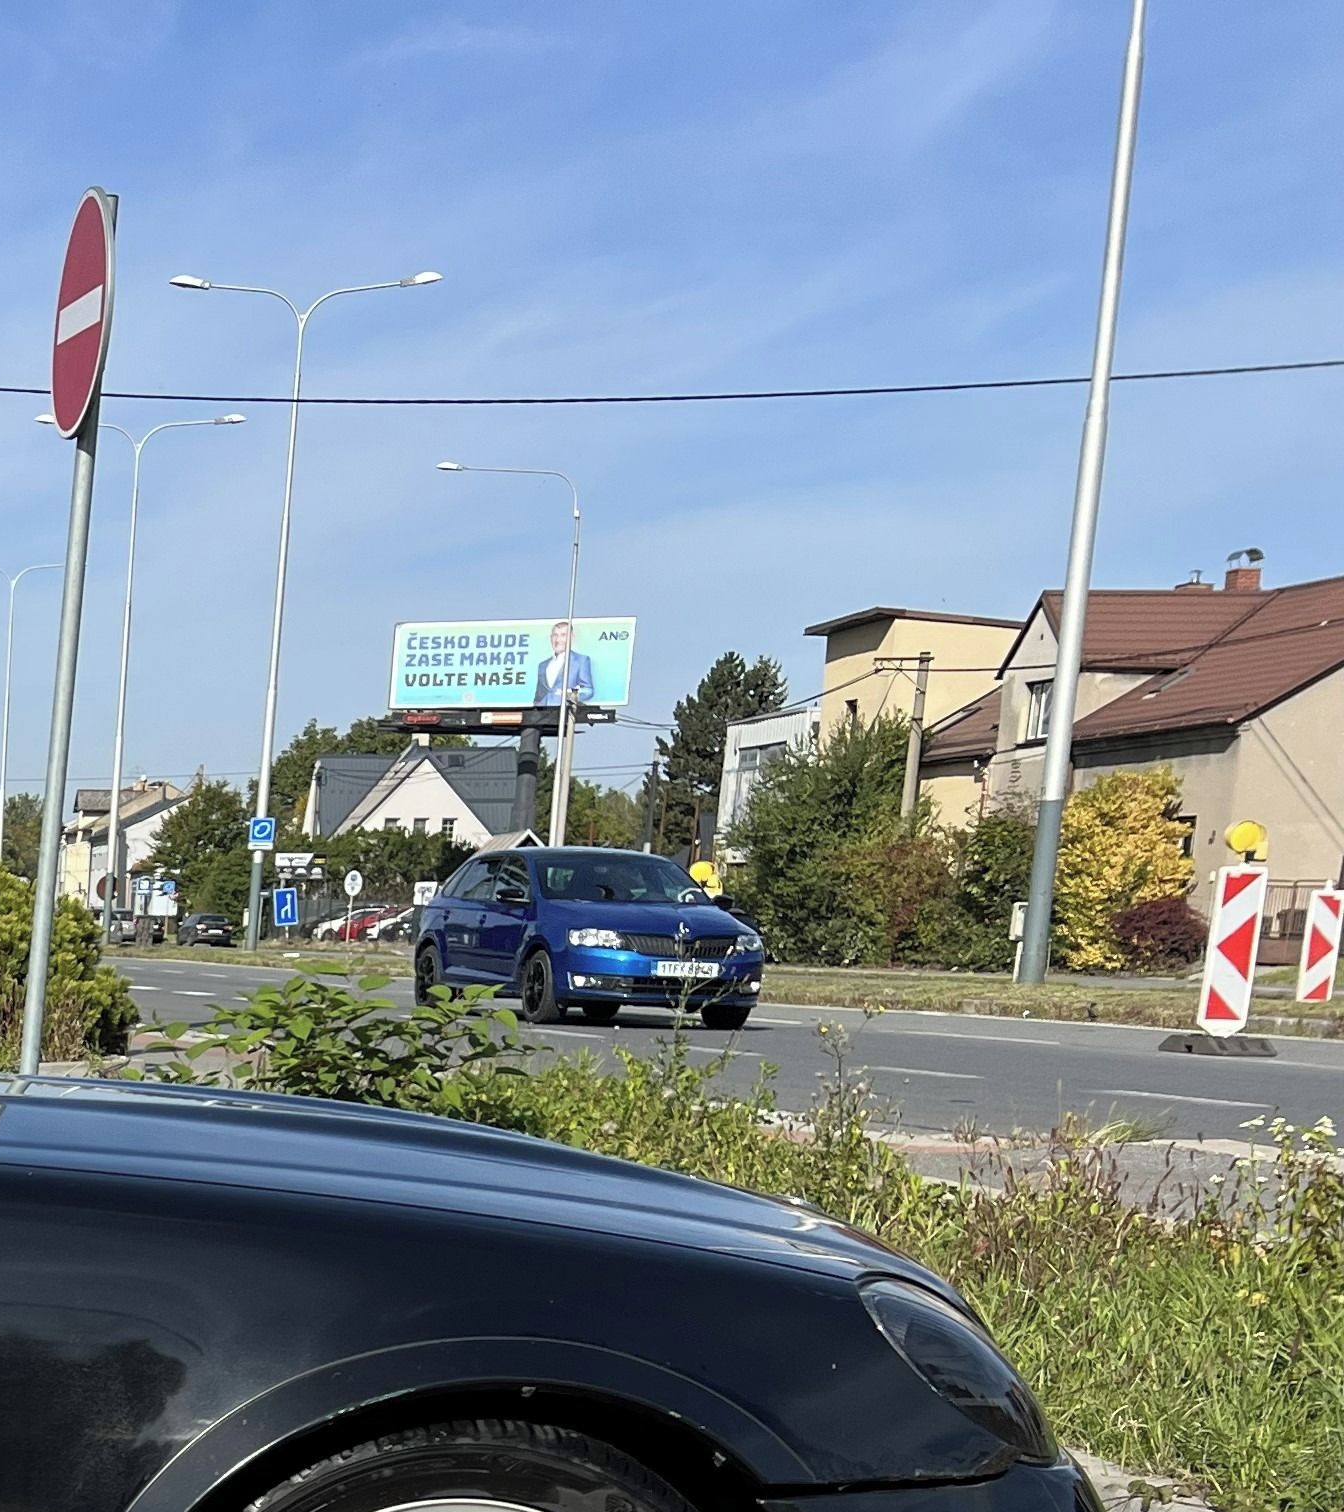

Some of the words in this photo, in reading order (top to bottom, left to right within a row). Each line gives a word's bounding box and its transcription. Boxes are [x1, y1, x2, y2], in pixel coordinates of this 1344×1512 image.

[406, 632, 470, 650] ČESKO
[475, 633, 530, 649] BUDE
[405, 652, 454, 667] ZASE
[459, 651, 529, 666] MAKAT
[404, 672, 468, 687] VOLTE
[474, 668, 527, 687] NAŠE
